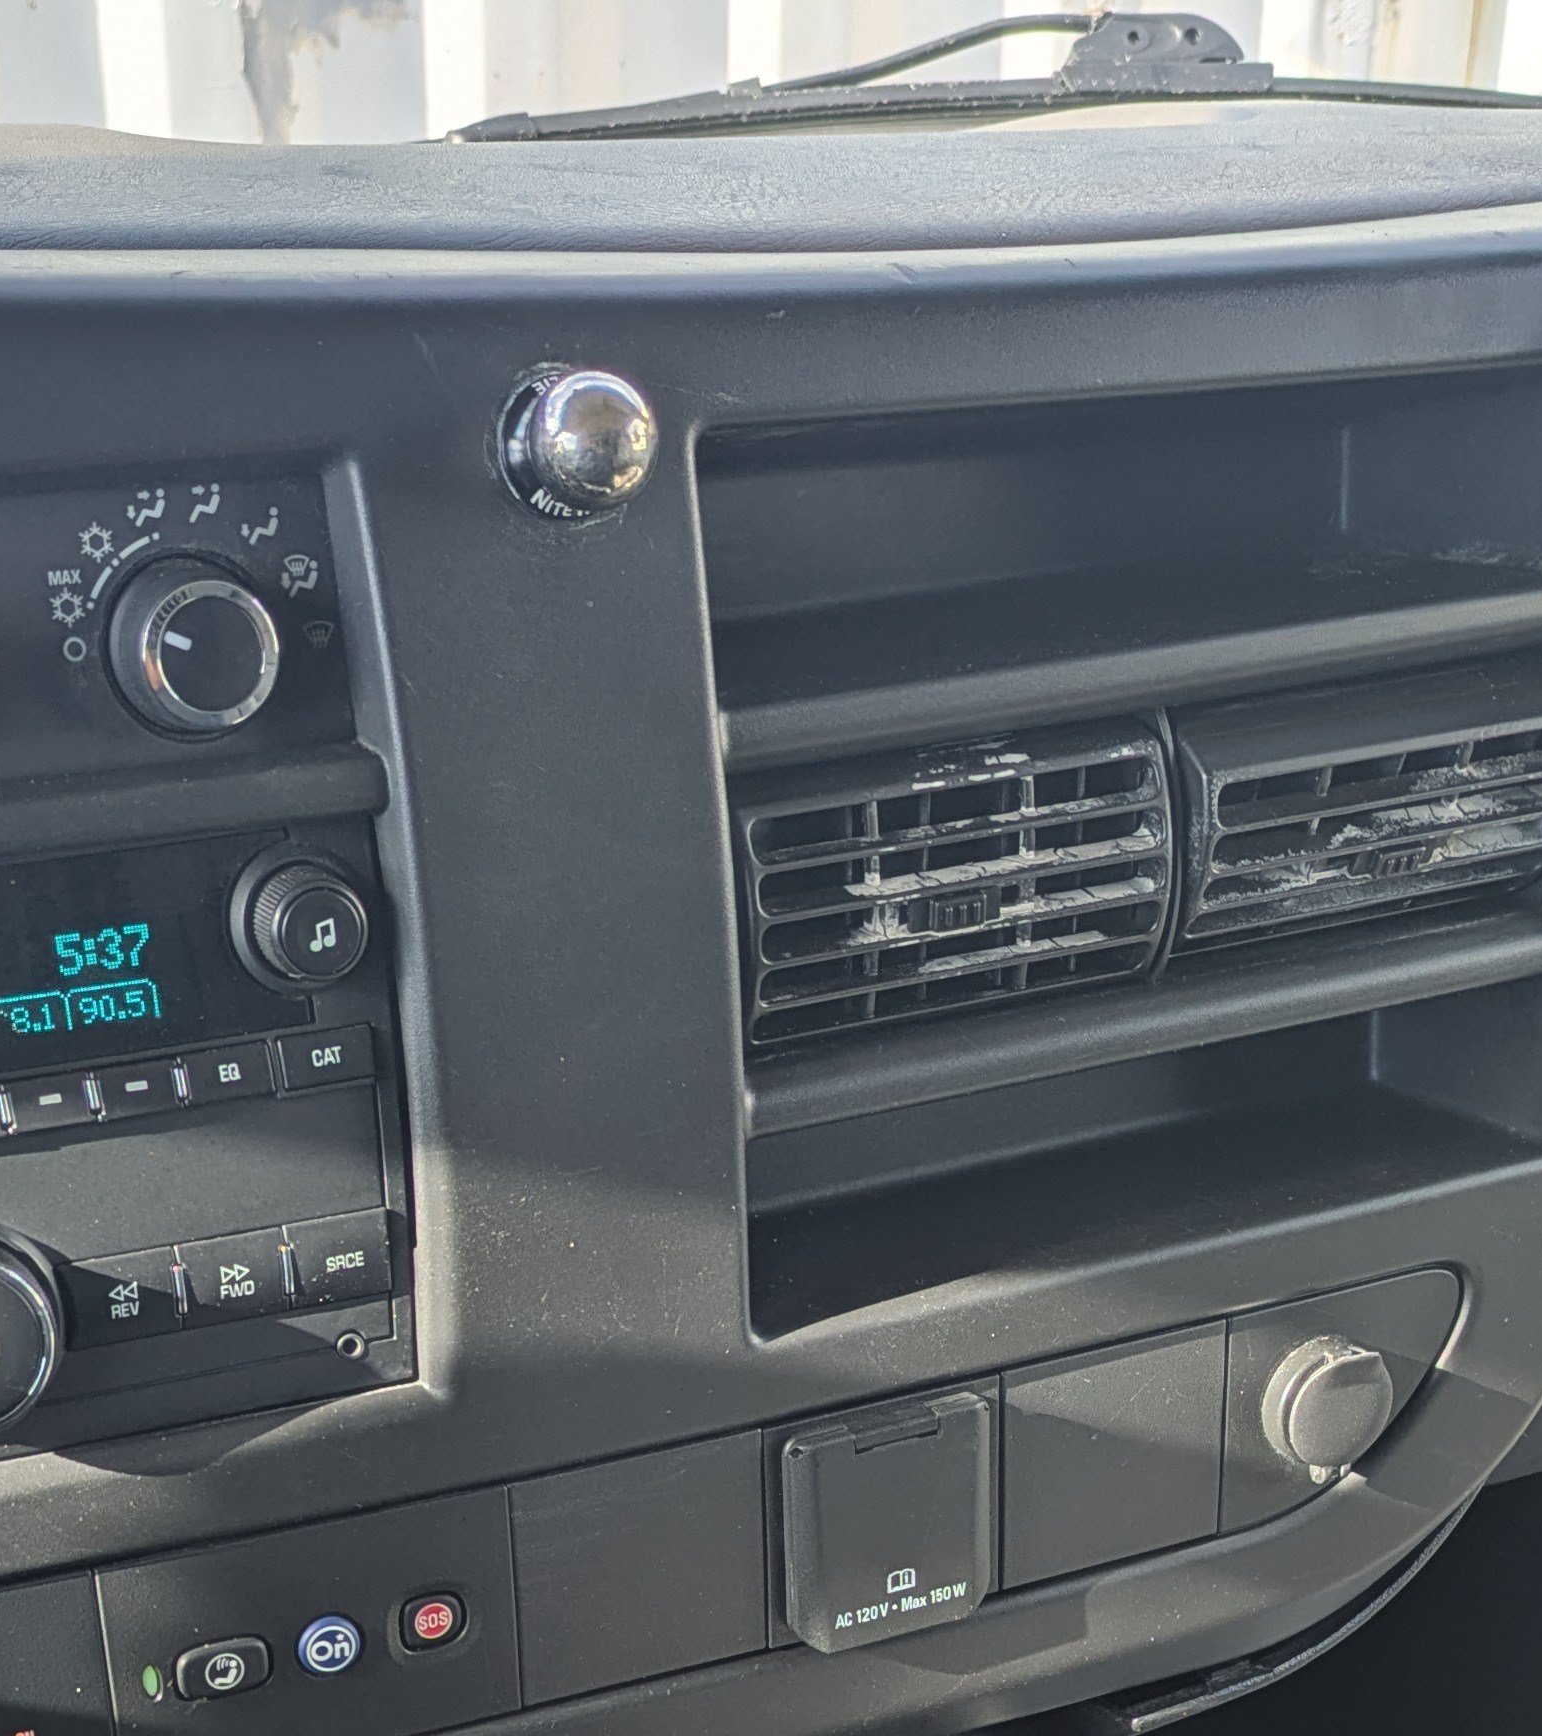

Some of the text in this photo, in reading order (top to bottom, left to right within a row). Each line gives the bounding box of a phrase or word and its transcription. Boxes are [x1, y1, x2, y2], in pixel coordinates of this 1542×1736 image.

[47, 568, 82, 586] MAX
[54, 923, 150, 977] 5:37
[78, 989, 146, 1035] 90.5
[311, 1045, 342, 1068] CAT
[217, 1062, 242, 1083] EQ
[326, 1251, 365, 1273] SRCE
[220, 1279, 255, 1299] FWD
[111, 1300, 140, 1320] REV
[417, 1611, 449, 1631] SOS
[834, 1611, 853, 1630] AC
[900, 1595, 928, 1613] Max
